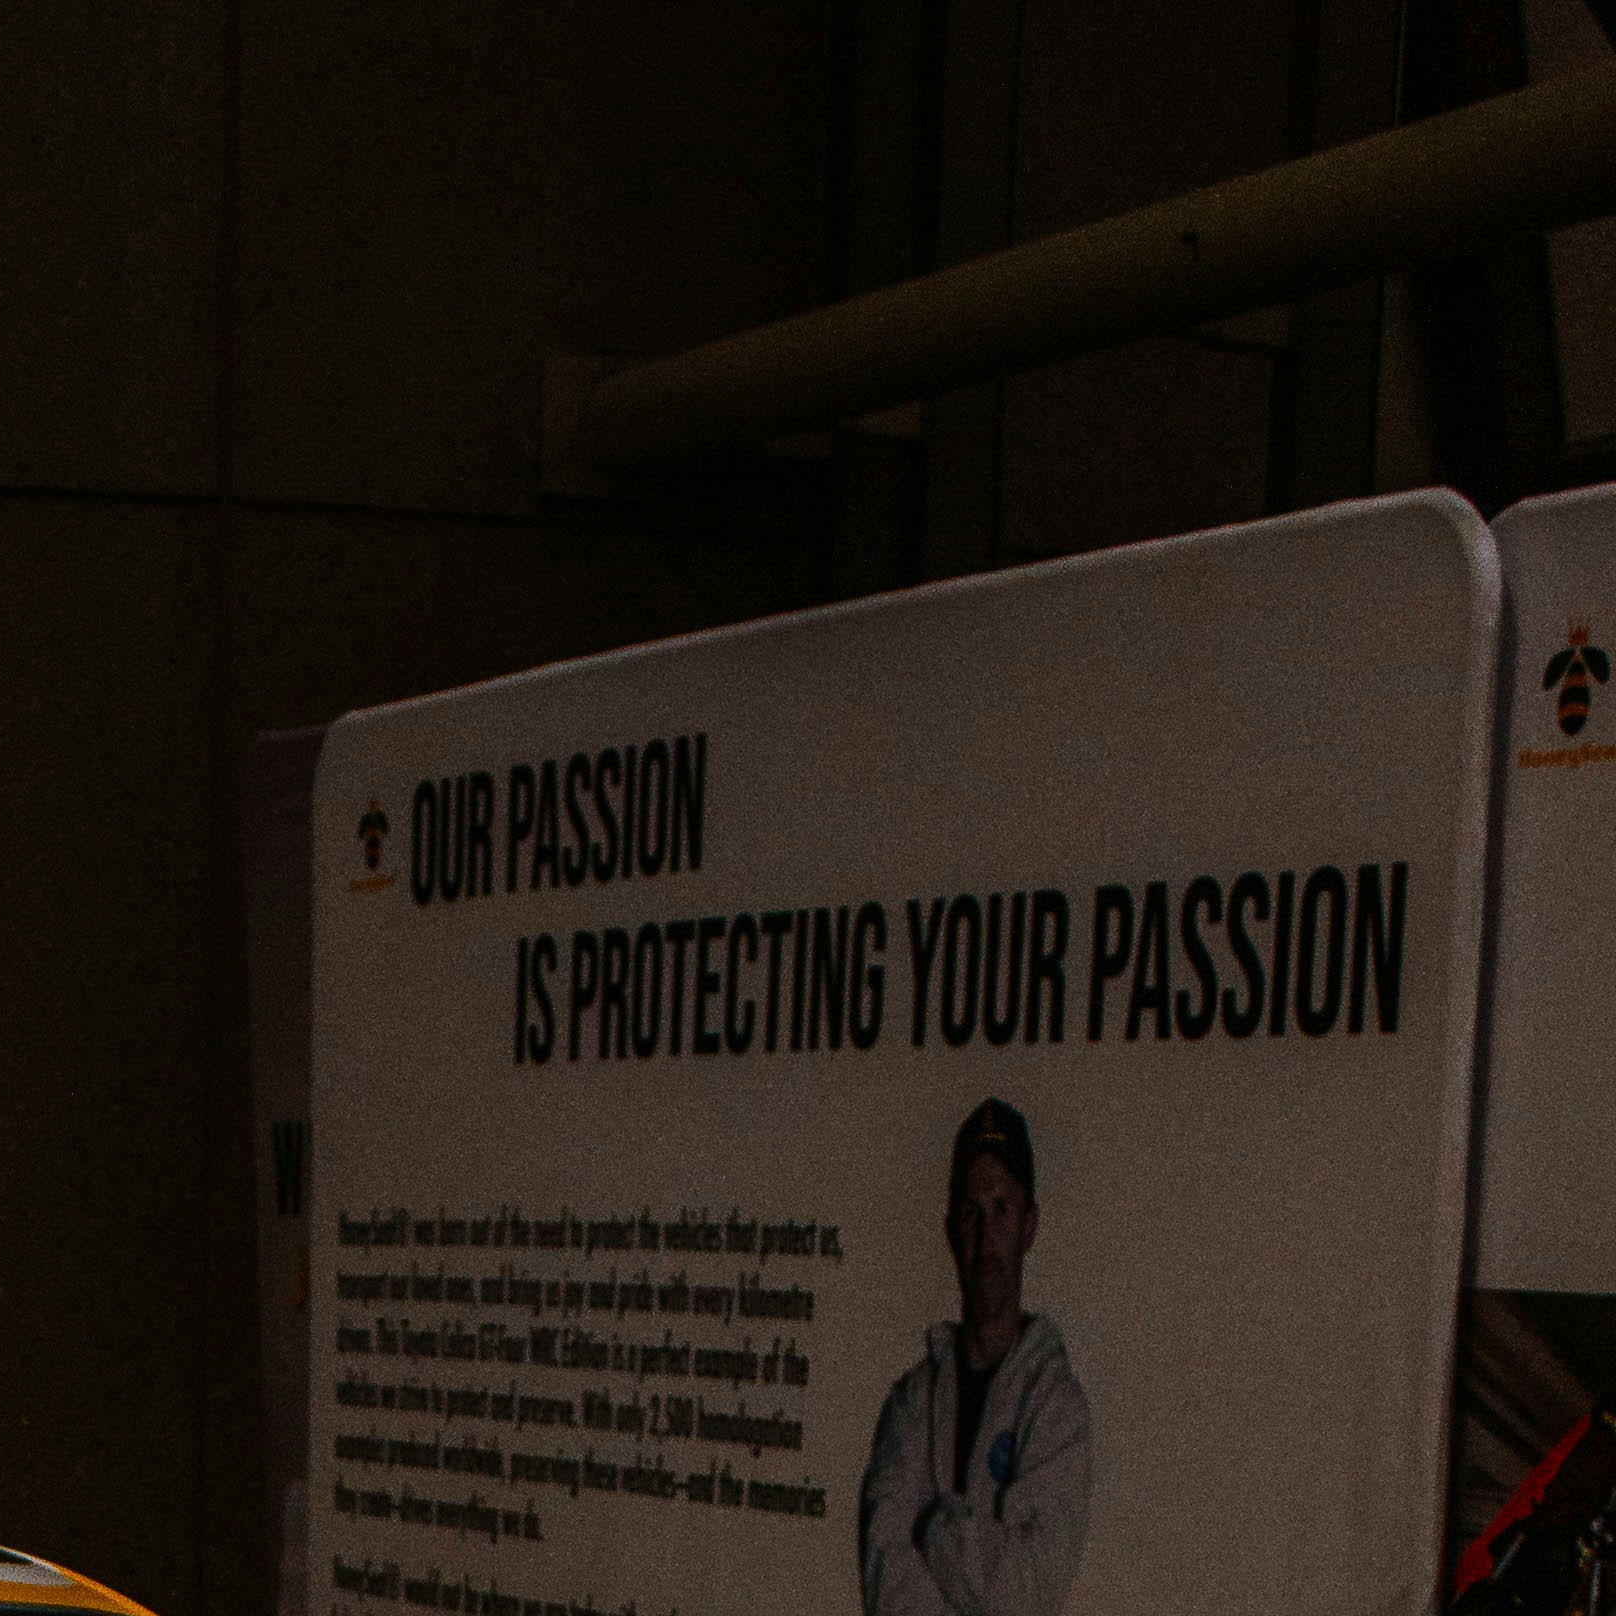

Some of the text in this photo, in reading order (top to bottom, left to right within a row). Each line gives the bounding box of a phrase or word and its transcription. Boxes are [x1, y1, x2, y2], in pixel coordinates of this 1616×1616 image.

[411, 733, 707, 907] OUR PASSION
[514, 862, 1409, 1066] IS PROTECTING YOUR PASSION
